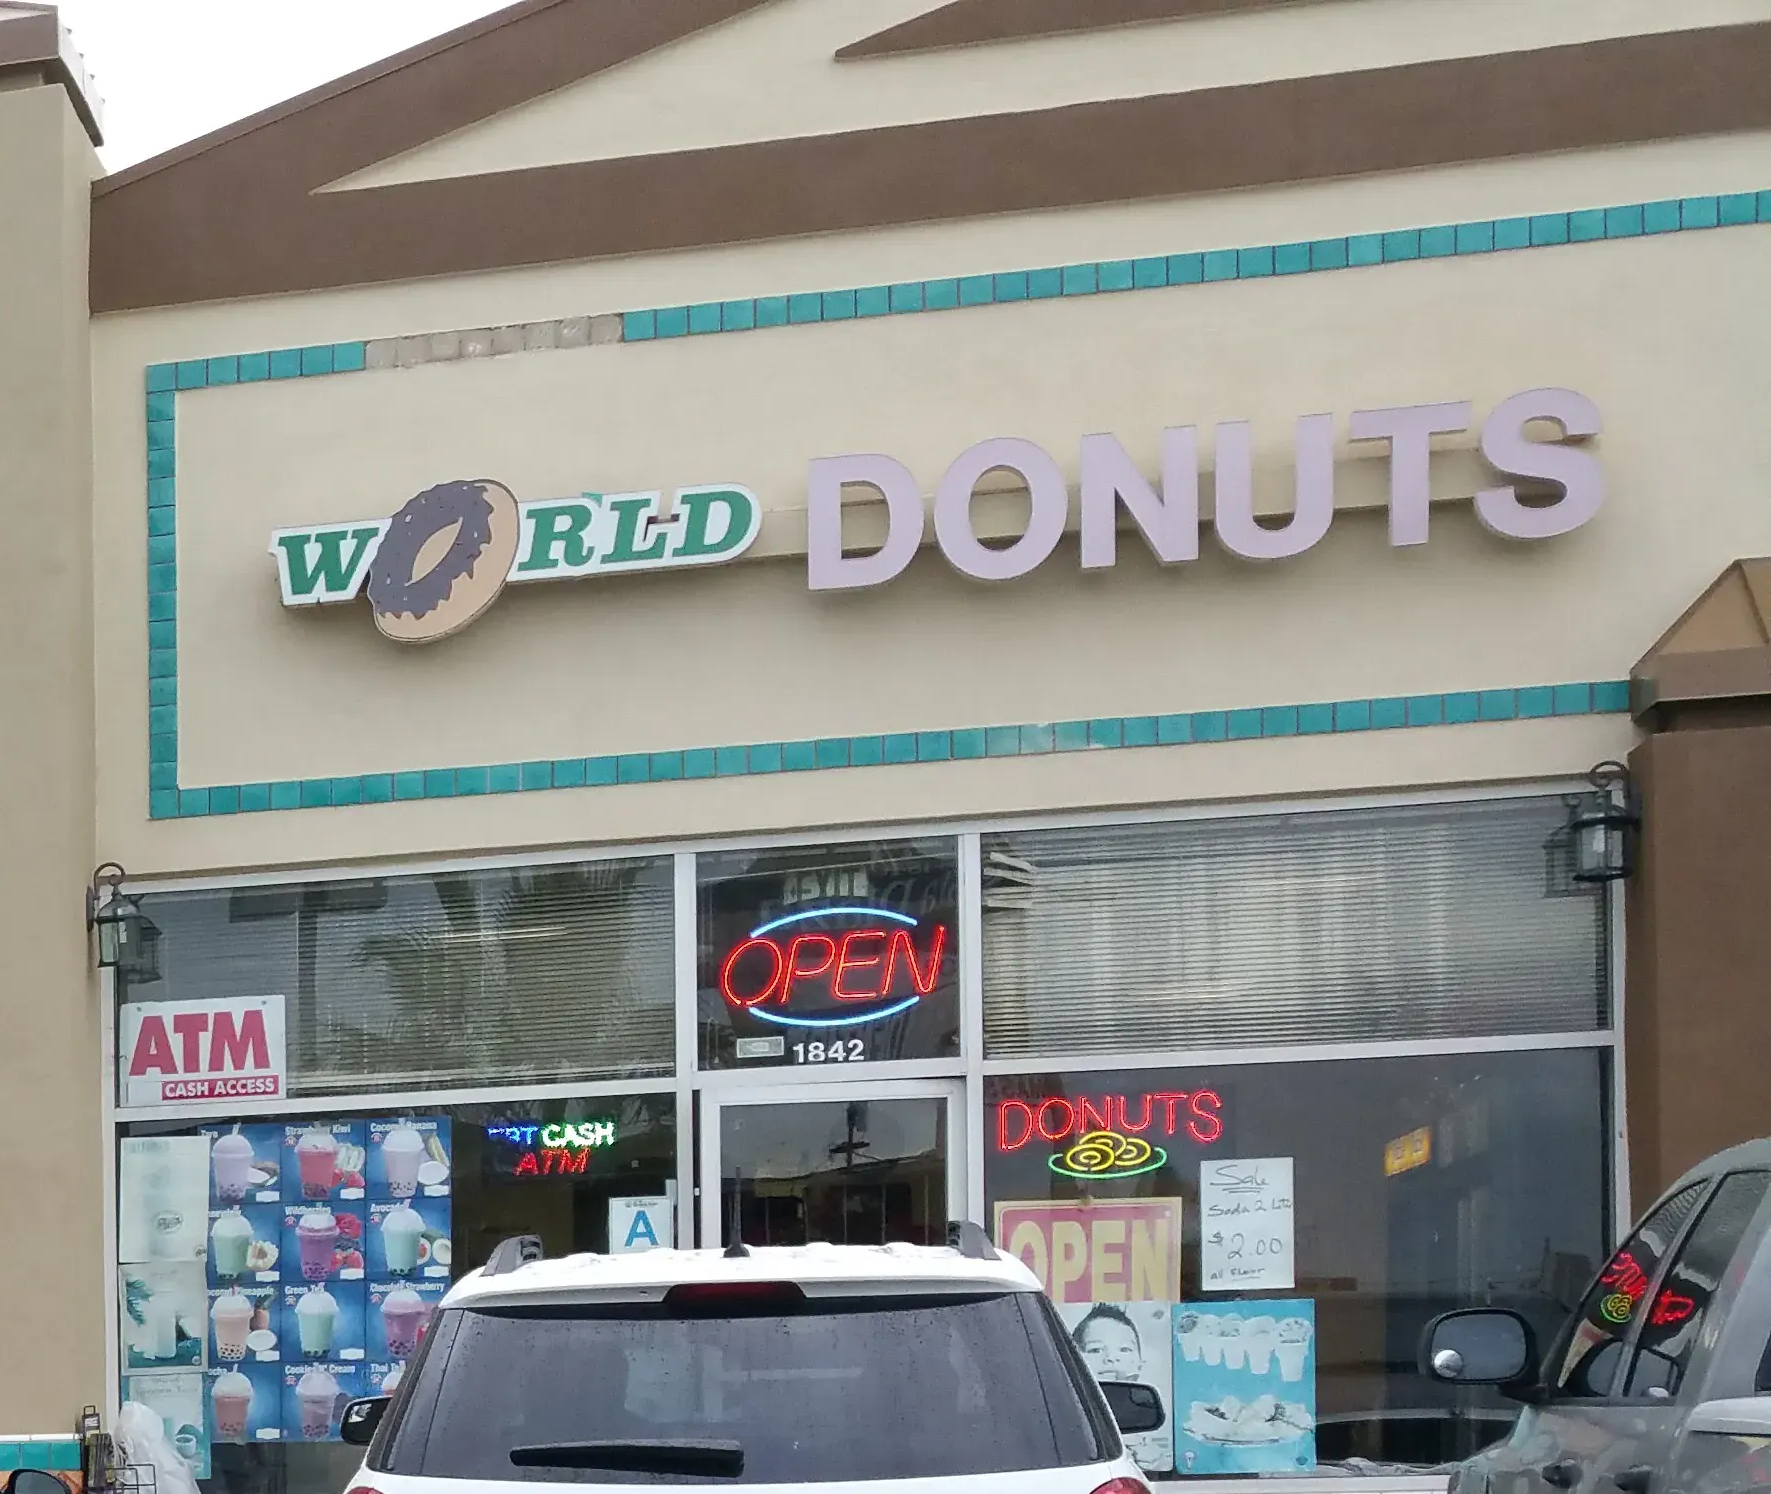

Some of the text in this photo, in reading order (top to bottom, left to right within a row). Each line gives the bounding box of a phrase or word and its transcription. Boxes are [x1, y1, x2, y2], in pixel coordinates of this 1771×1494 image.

[806, 387, 1606, 592] DONUTS
[721, 923, 946, 1006] OPEN
[129, 1009, 271, 1076] ATM
[792, 1038, 865, 1063] 1842
[165, 1077, 275, 1098] CASH ACCESS
[540, 1121, 616, 1148] CASH
[999, 1091, 1222, 1150] DONUTS
[514, 1147, 591, 1176] ATM
[1209, 1164, 1270, 1187] Sale
[624, 1210, 660, 1247] A
[1010, 1219, 1169, 1302] OPEN
